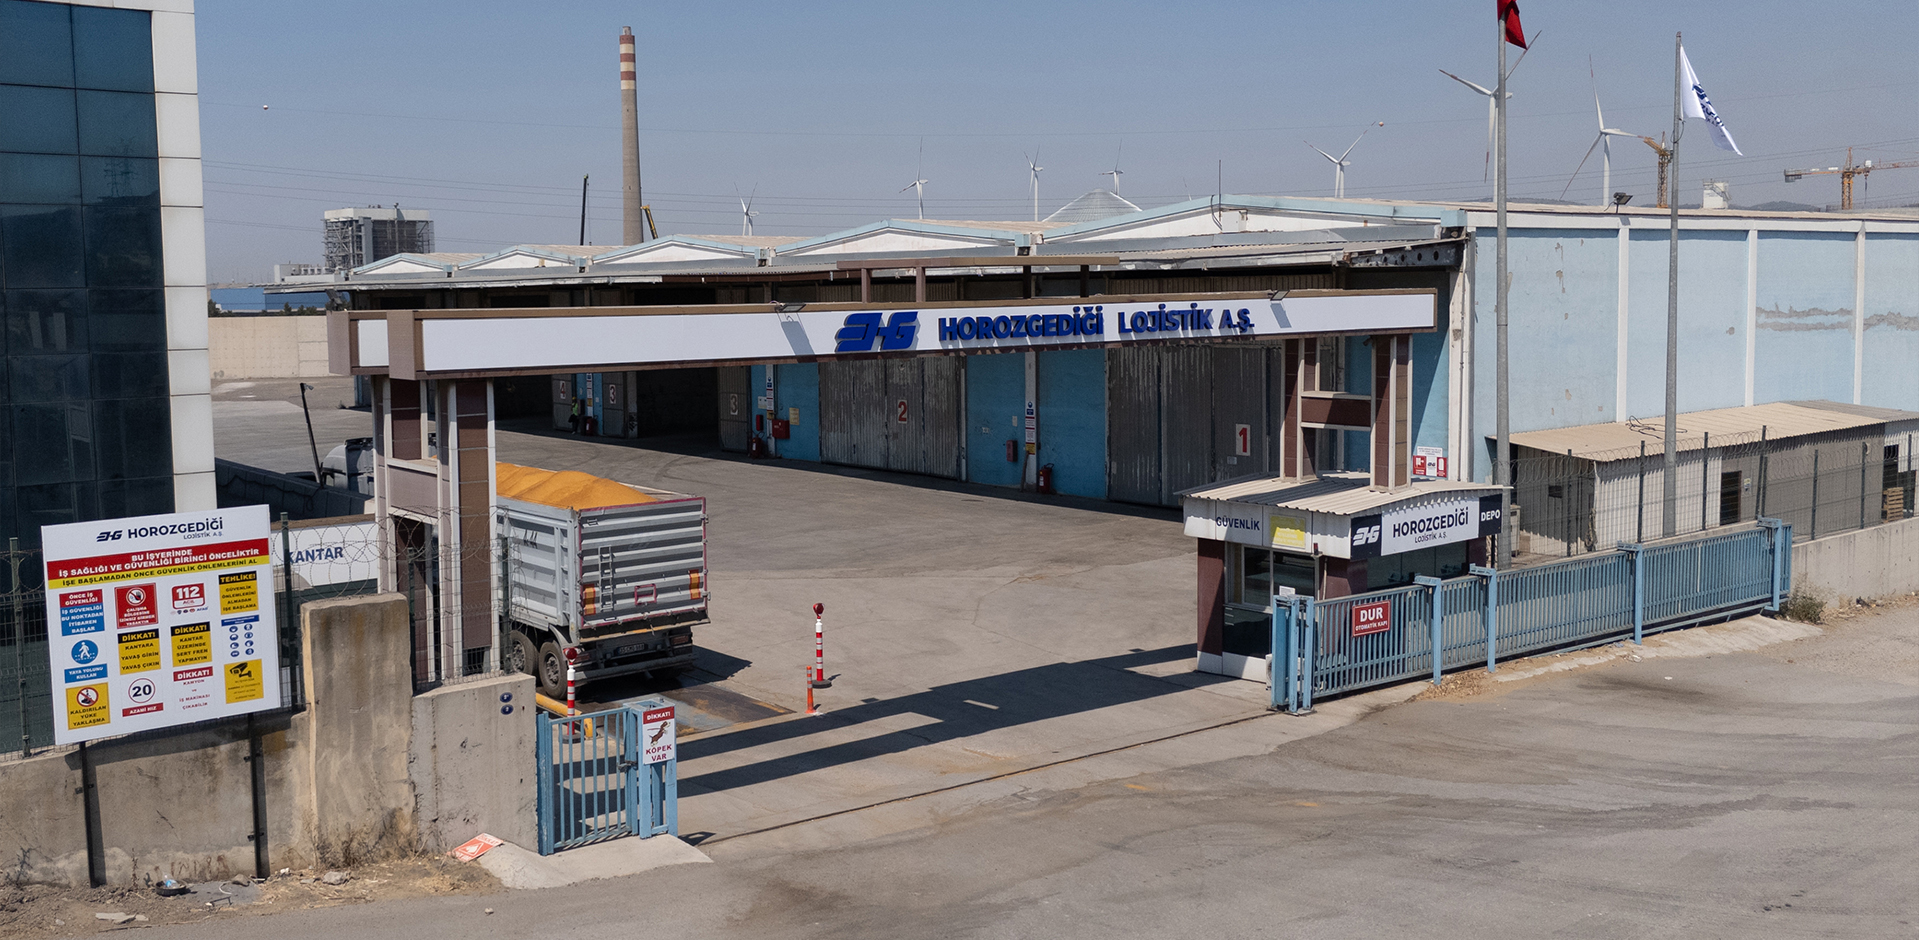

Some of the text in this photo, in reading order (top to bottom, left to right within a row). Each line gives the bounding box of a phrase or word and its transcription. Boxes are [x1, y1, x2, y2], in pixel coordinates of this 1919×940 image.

[938, 305, 1104, 341] HOROZGEDİĞİ
[1118, 303, 1213, 333] LOJİSTİK
[1219, 308, 1255, 333] A.Ş.
[609, 386, 616, 403] 3
[730, 395, 738, 413] 3
[898, 401, 907, 421] 2
[1238, 427, 1248, 453] 1
[1392, 506, 1469, 538] HOROZGEDİĞİ
[1480, 509, 1501, 522] DEPO
[127, 517, 223, 539] HOROZGEDİĞİ
[1215, 514, 1260, 531] GÜVENLİK
[183, 532, 211, 540] LOJİSTİK
[1414, 532, 1437, 544] LOJİSTİK
[131, 549, 193, 562] BU İŞYERİNDE
[289, 547, 343, 564] KANTAR
[59, 569, 69, 577] İŞ
[70, 565, 108, 576] SAĞLIĞI
[124, 557, 173, 570] GÜVENLİĞİ
[174, 553, 207, 564] BİRİNCİ
[208, 548, 260, 560] ÖNCELİKTİR
[78, 574, 131, 584] BAŞLAMADAN
[133, 569, 155, 578] ÖNCE
[156, 566, 195, 575] GÜVENLİK
[197, 559, 247, 570] ÖNLEMLERİNİ
[220, 573, 256, 583] TEHLİKE!
[176, 586, 200, 599] 112
[71, 611, 104, 620] NOKTADAN
[1360, 607, 1383, 622] DUR
[174, 624, 207, 635] DİKKAT!
[122, 631, 156, 642] DİKKAT!
[177, 642, 206, 650] ÜZERİNDE
[178, 656, 208, 664] YAPMAYIN
[177, 669, 210, 680] DİKKAT!
[132, 684, 152, 697] 20
[70, 705, 107, 715] KALDIRILAN
[73, 717, 106, 726] YAKLAŞMA
[645, 744, 672, 755] KÖPEK
[651, 753, 667, 762] VAR
